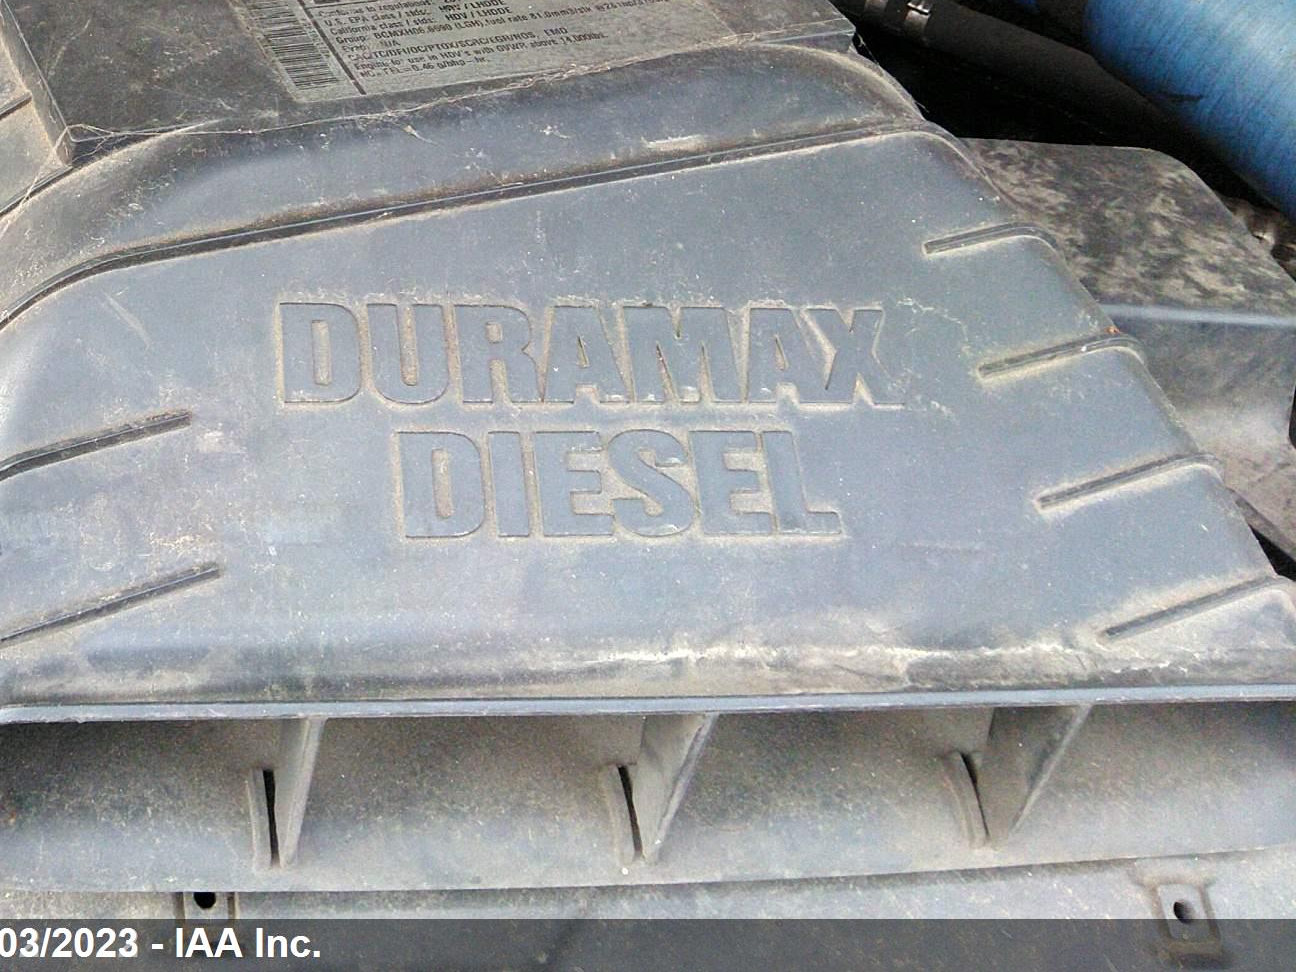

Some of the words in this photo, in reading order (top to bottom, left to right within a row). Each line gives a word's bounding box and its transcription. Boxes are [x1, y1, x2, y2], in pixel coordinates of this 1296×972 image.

[329, 24, 377, 34] California
[444, 12, 468, 20] HDV
[476, 7, 513, 16] LHDDE
[278, 302, 907, 406] DURAMAX
[393, 430, 843, 539] DIESEL
